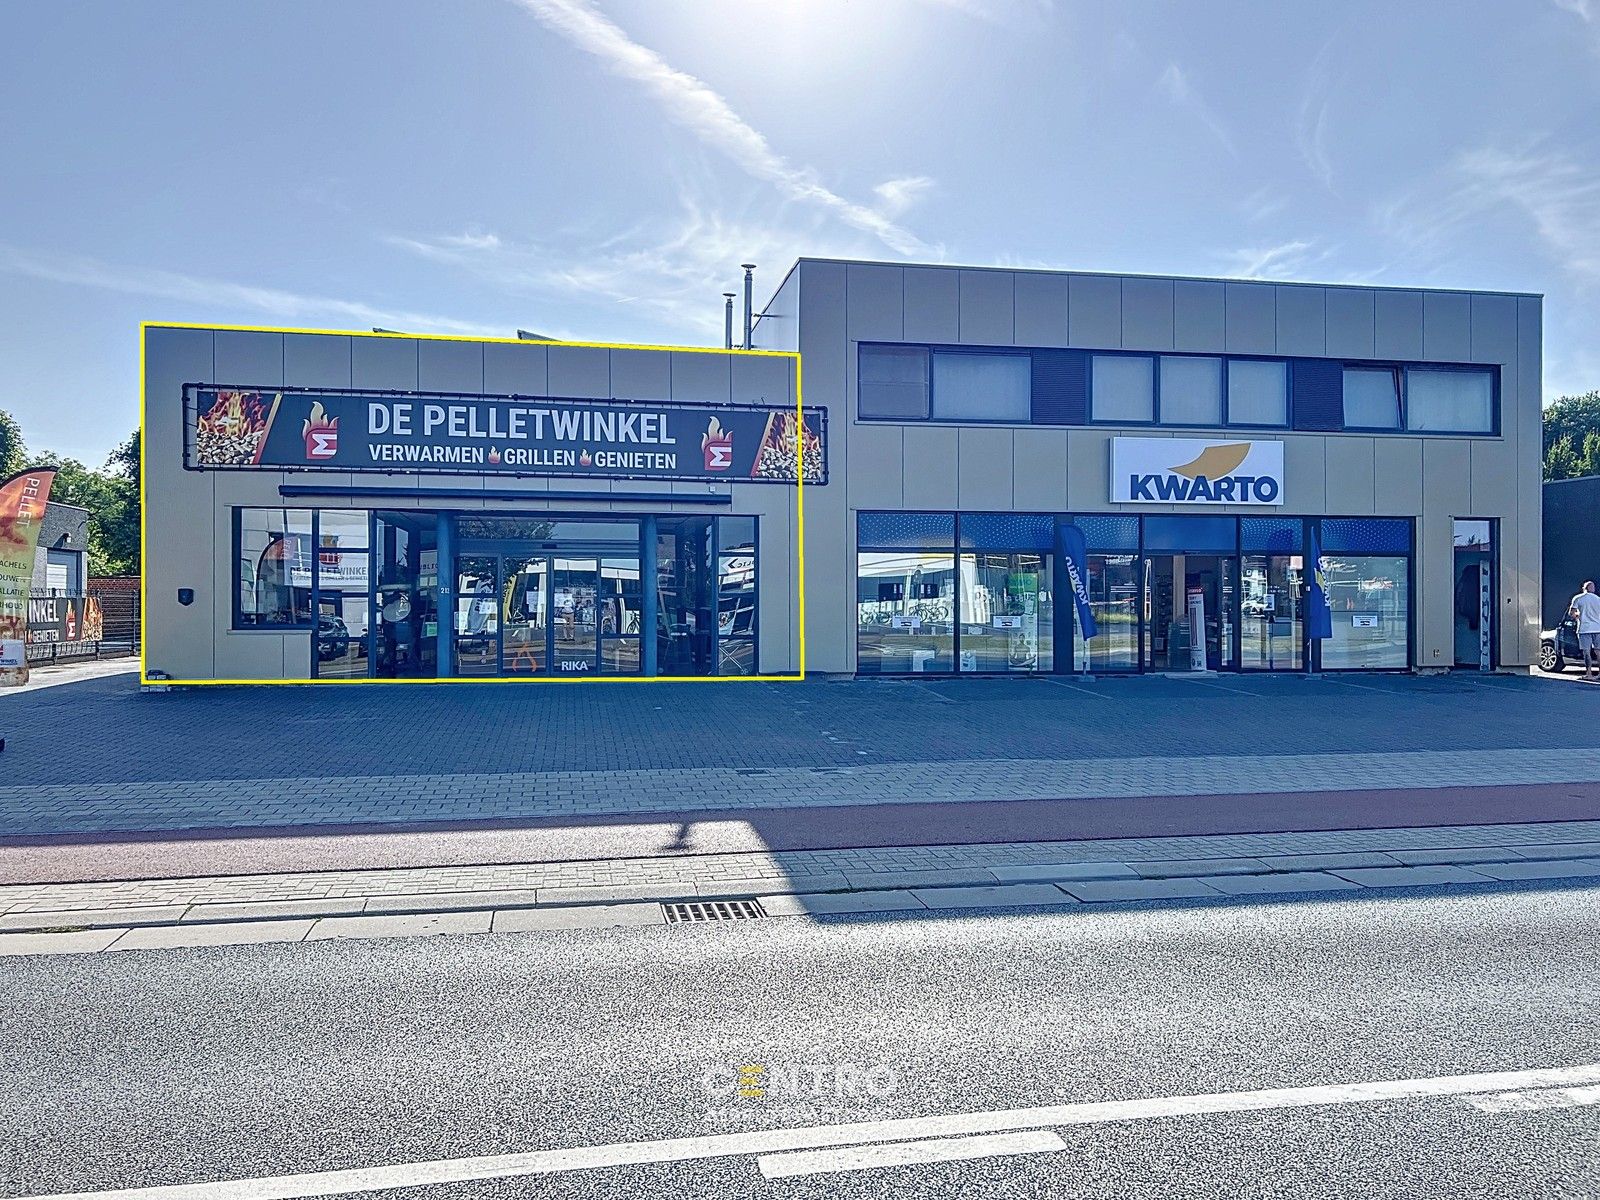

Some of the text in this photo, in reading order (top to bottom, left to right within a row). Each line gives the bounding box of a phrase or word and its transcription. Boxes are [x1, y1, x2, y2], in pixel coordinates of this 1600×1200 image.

[369, 403, 676, 444] DE PELLETWINKEL
[369, 444, 677, 469] VERWARMEN GRILLEN GENIETEN
[1130, 474, 1279, 502] KWARTO
[16, 477, 40, 529] PELLET
[561, 660, 589, 671] RIKA
